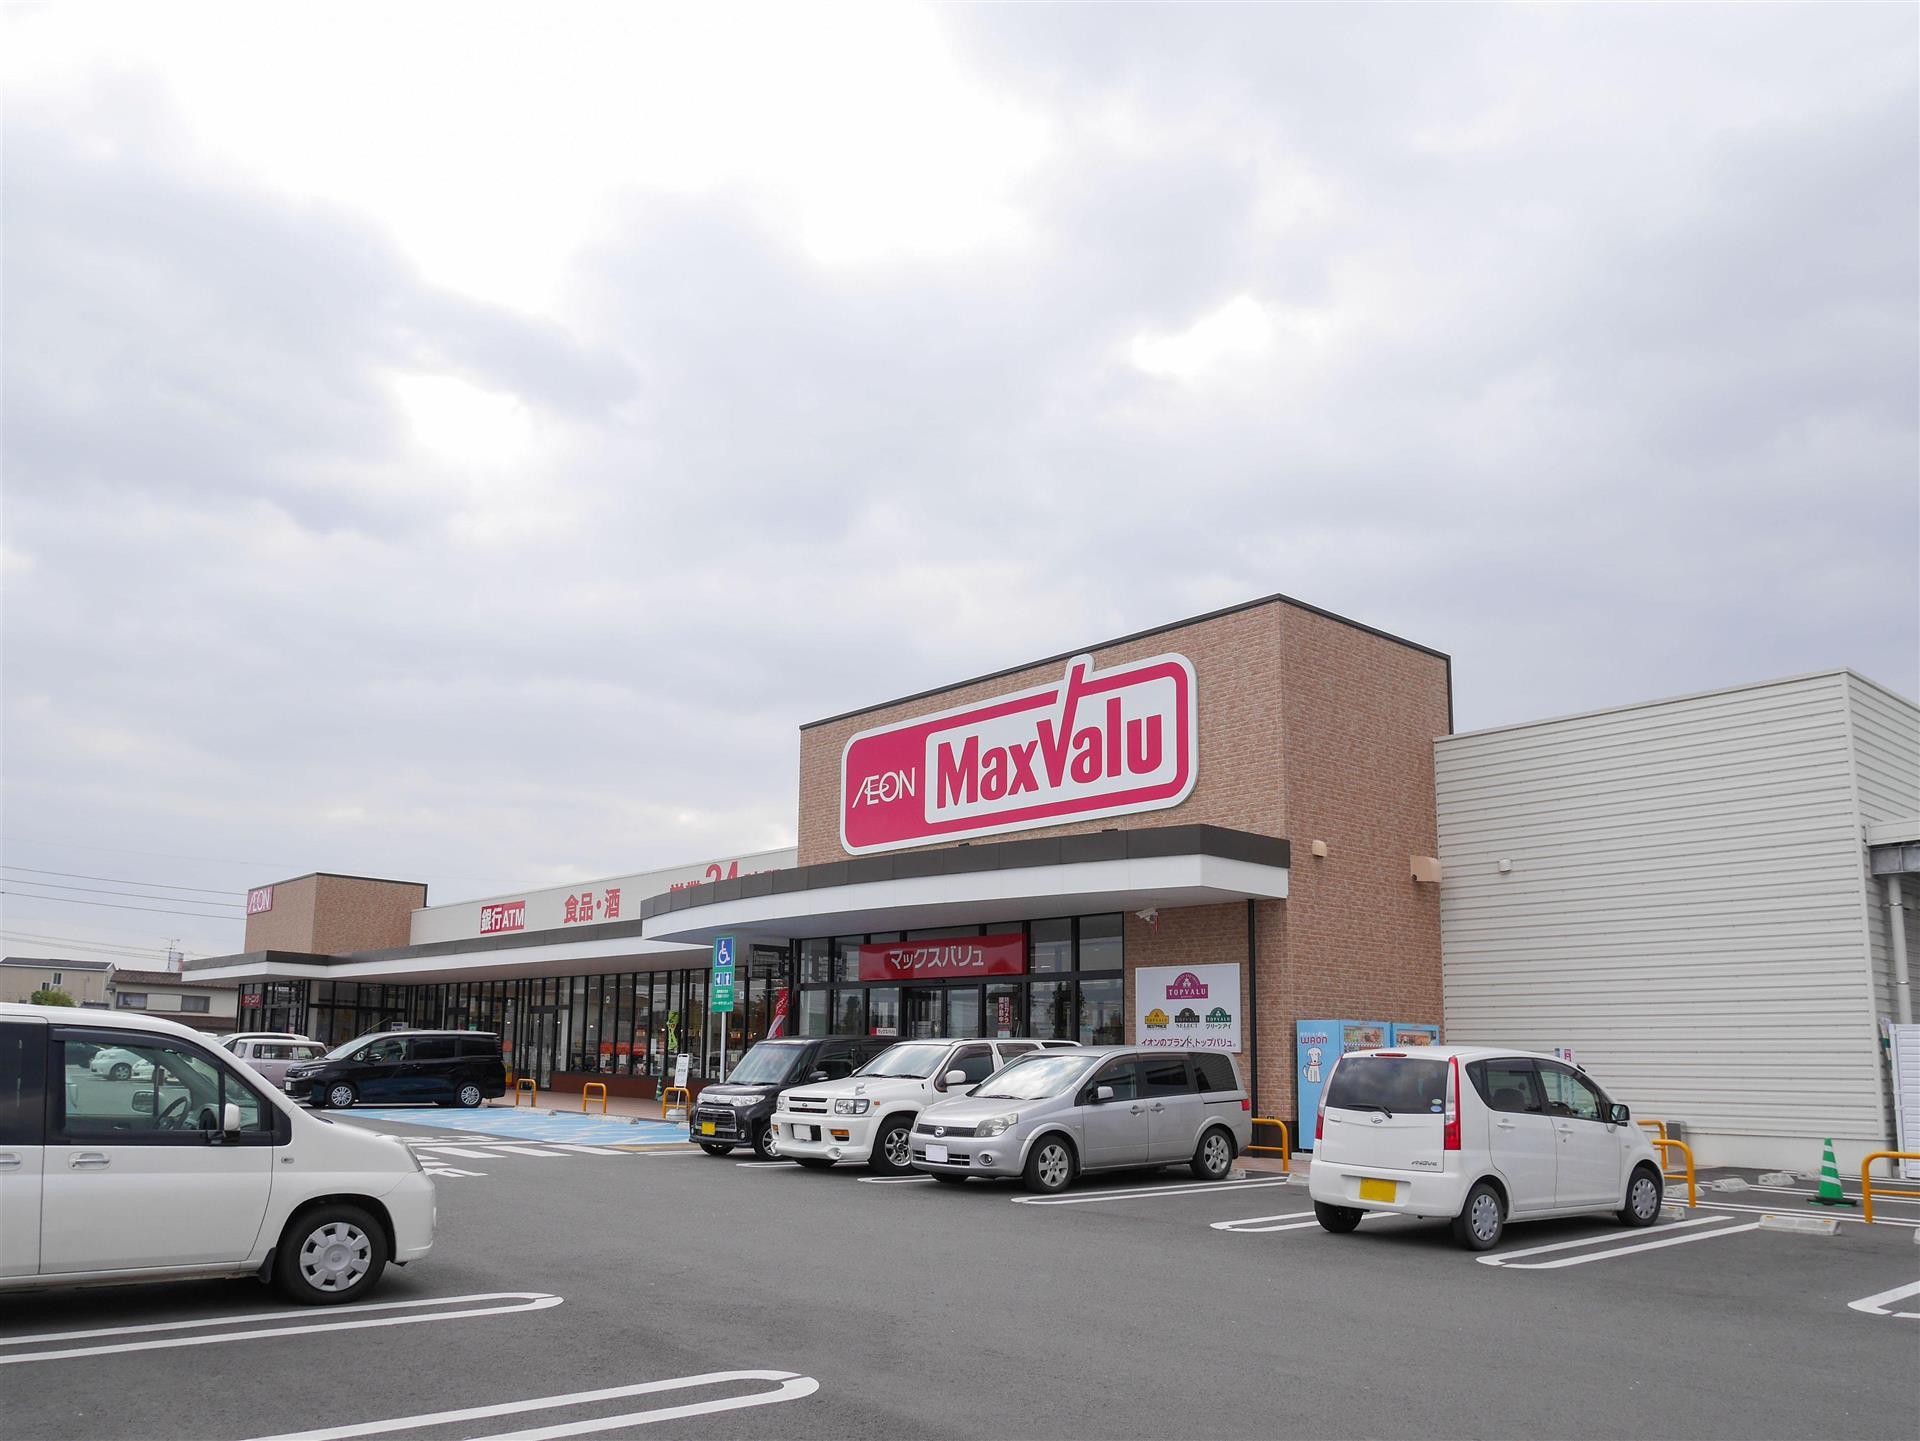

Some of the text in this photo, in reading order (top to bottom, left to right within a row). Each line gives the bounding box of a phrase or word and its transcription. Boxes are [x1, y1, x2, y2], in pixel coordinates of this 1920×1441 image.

[937, 663, 1163, 810] MaxValu
[563, 888, 621, 924] 食品・酒
[889, 945, 985, 970] マックスバリュ
